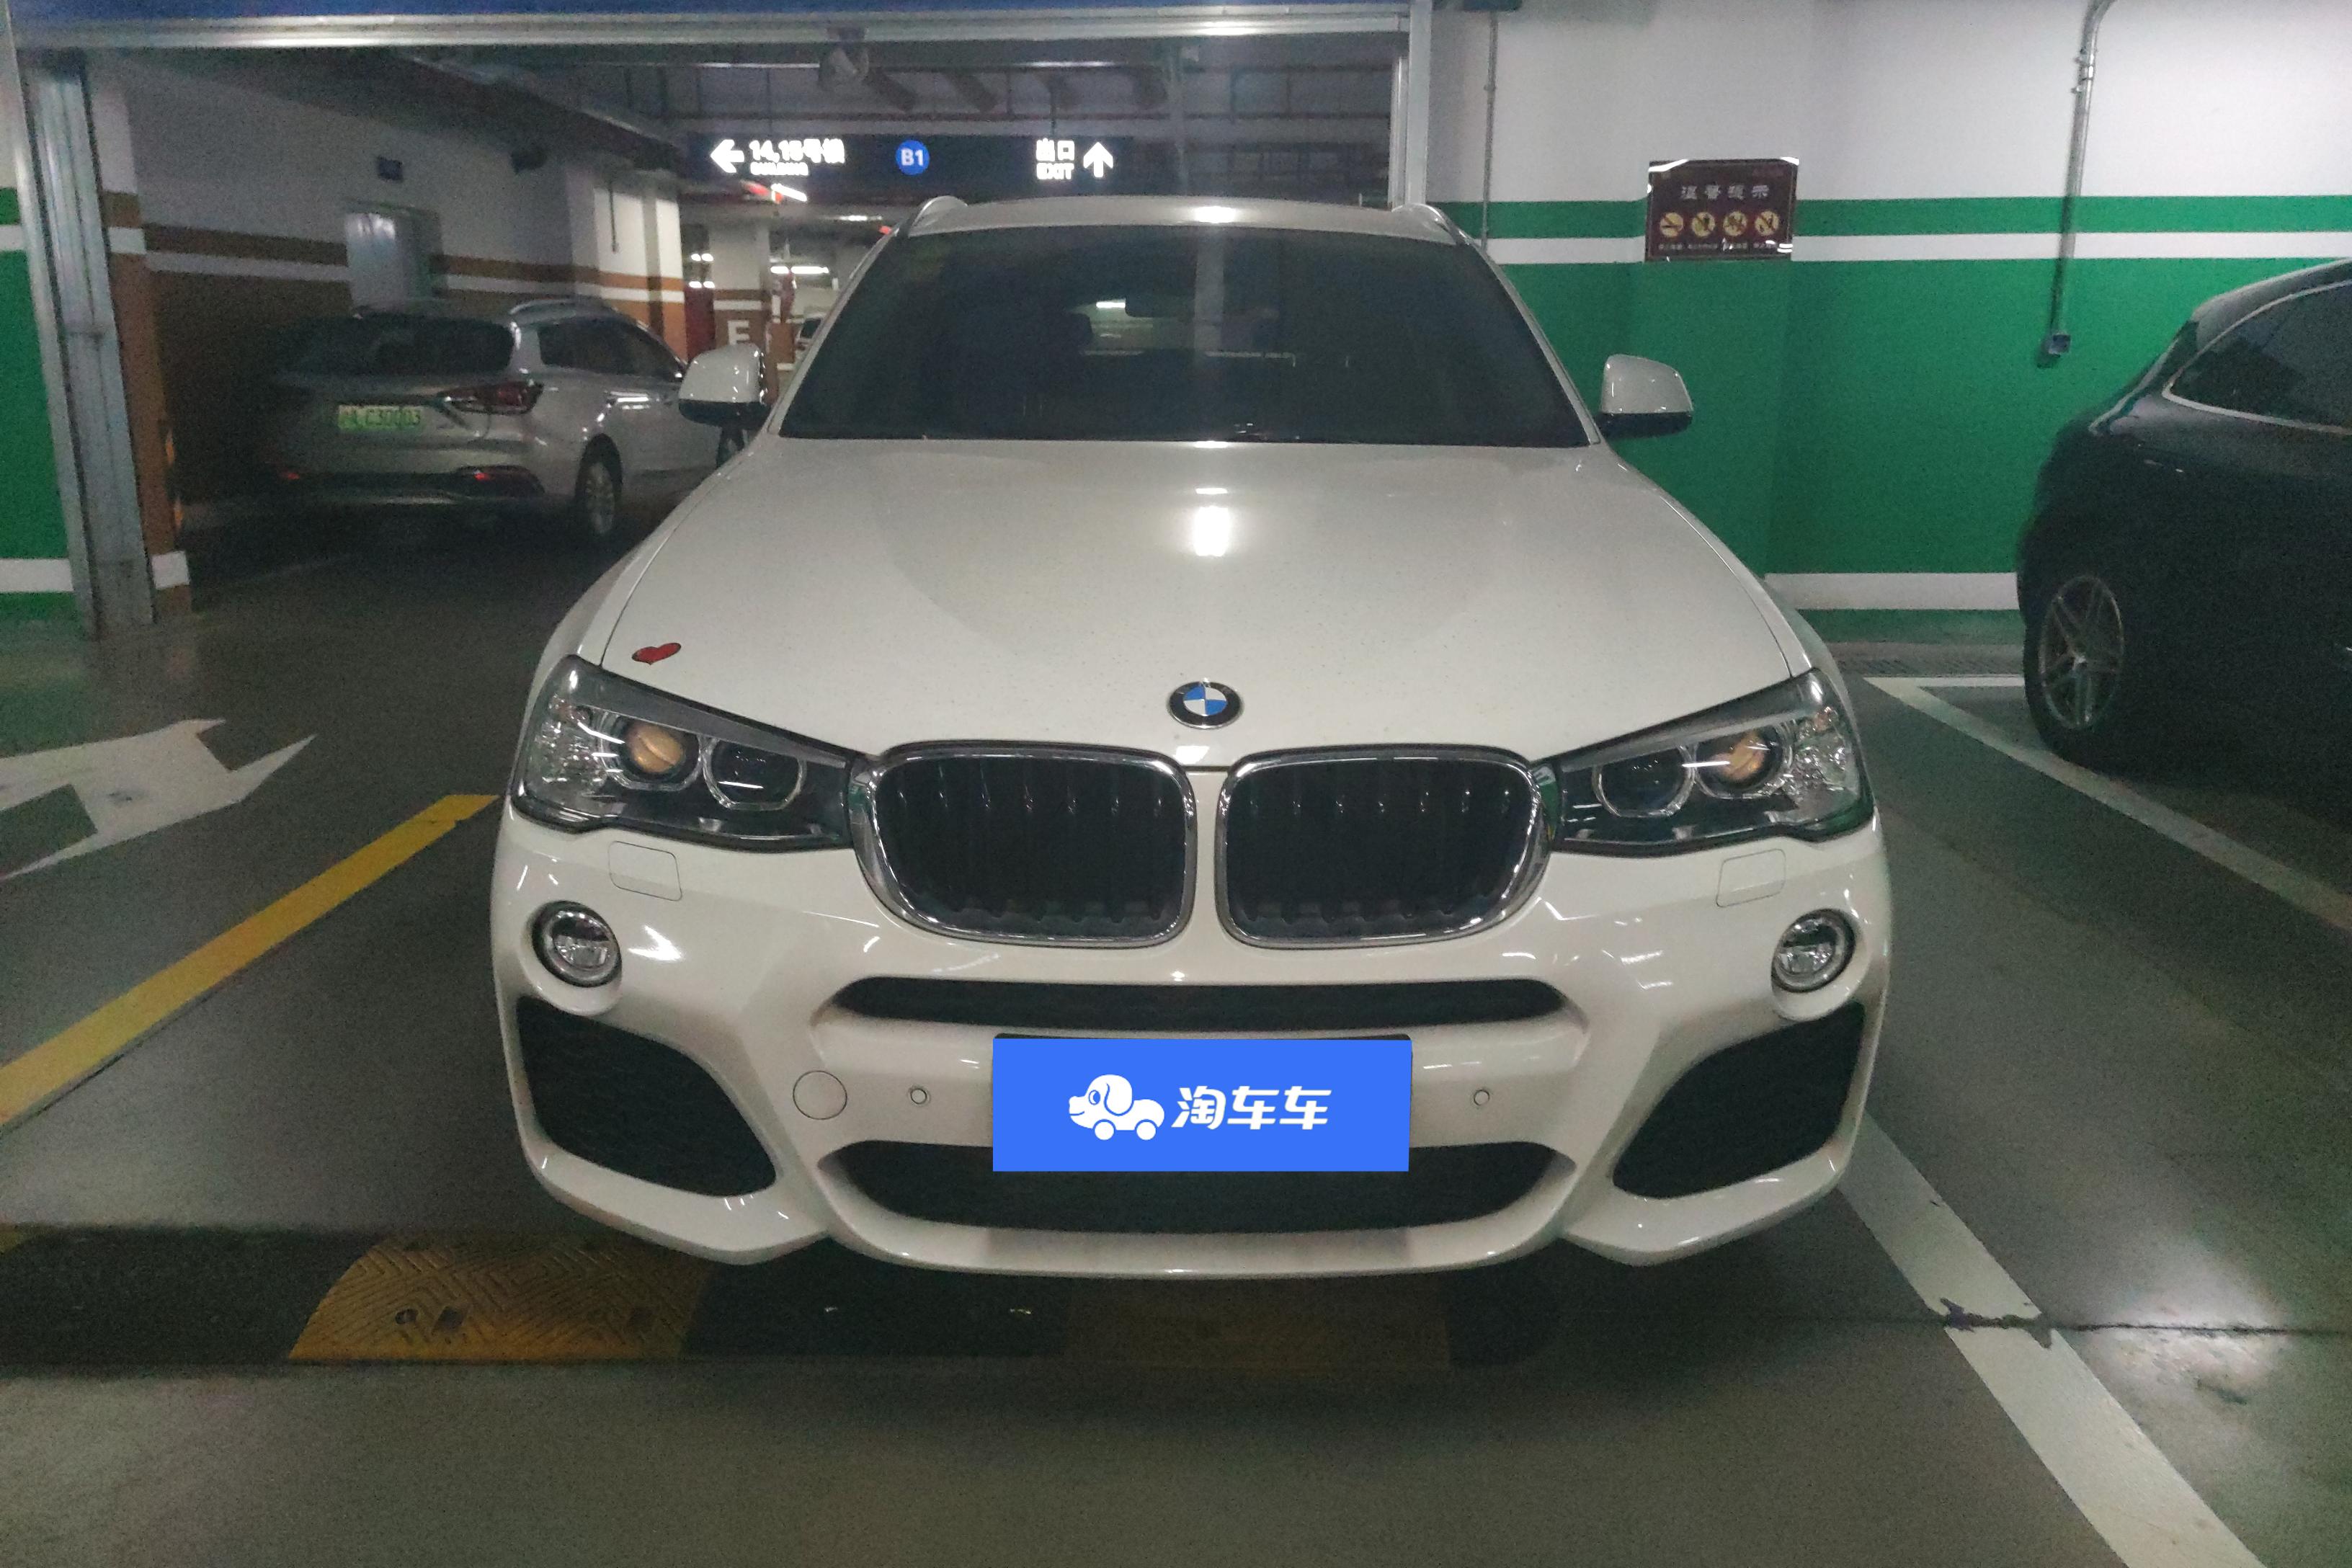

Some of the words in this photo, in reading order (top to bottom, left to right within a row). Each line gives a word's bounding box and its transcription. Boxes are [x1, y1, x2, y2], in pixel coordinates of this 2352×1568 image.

[901, 148, 924, 166] B1
[1036, 138, 1075, 161] 出口
[1036, 163, 1074, 179] EXIT
